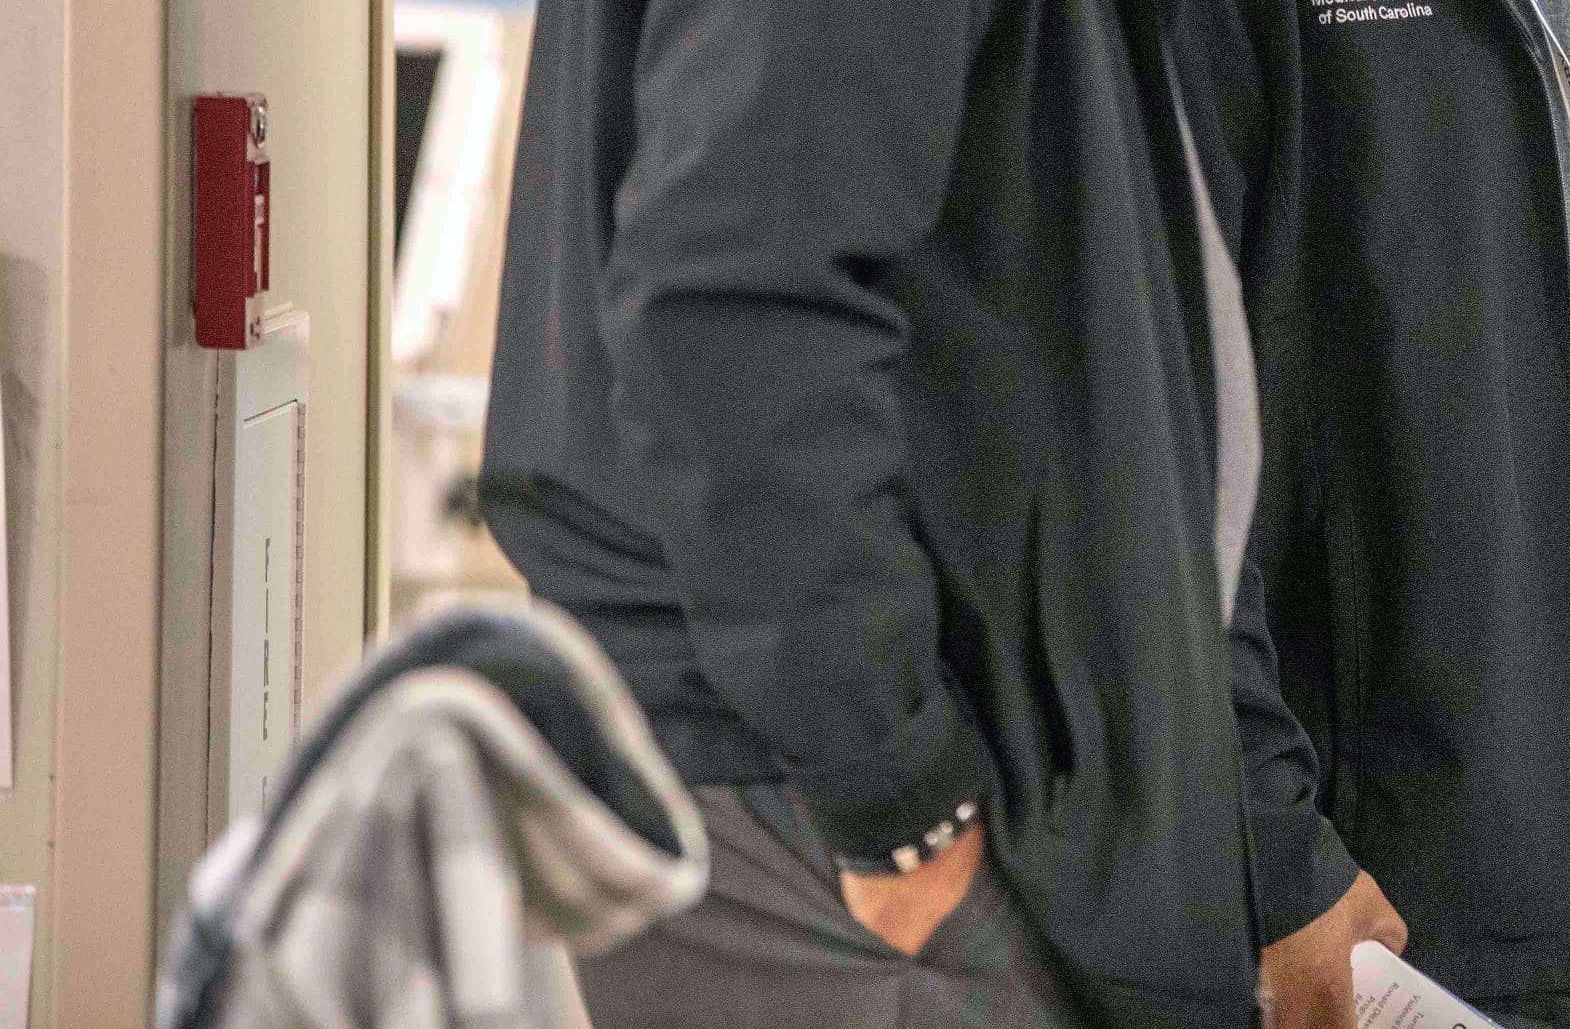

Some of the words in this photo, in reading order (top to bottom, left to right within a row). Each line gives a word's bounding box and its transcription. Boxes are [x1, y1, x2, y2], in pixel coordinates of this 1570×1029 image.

[1318, 10, 1332, 24] of
[1336, 5, 1377, 23] South
[1379, 3, 1433, 20] Carolina
